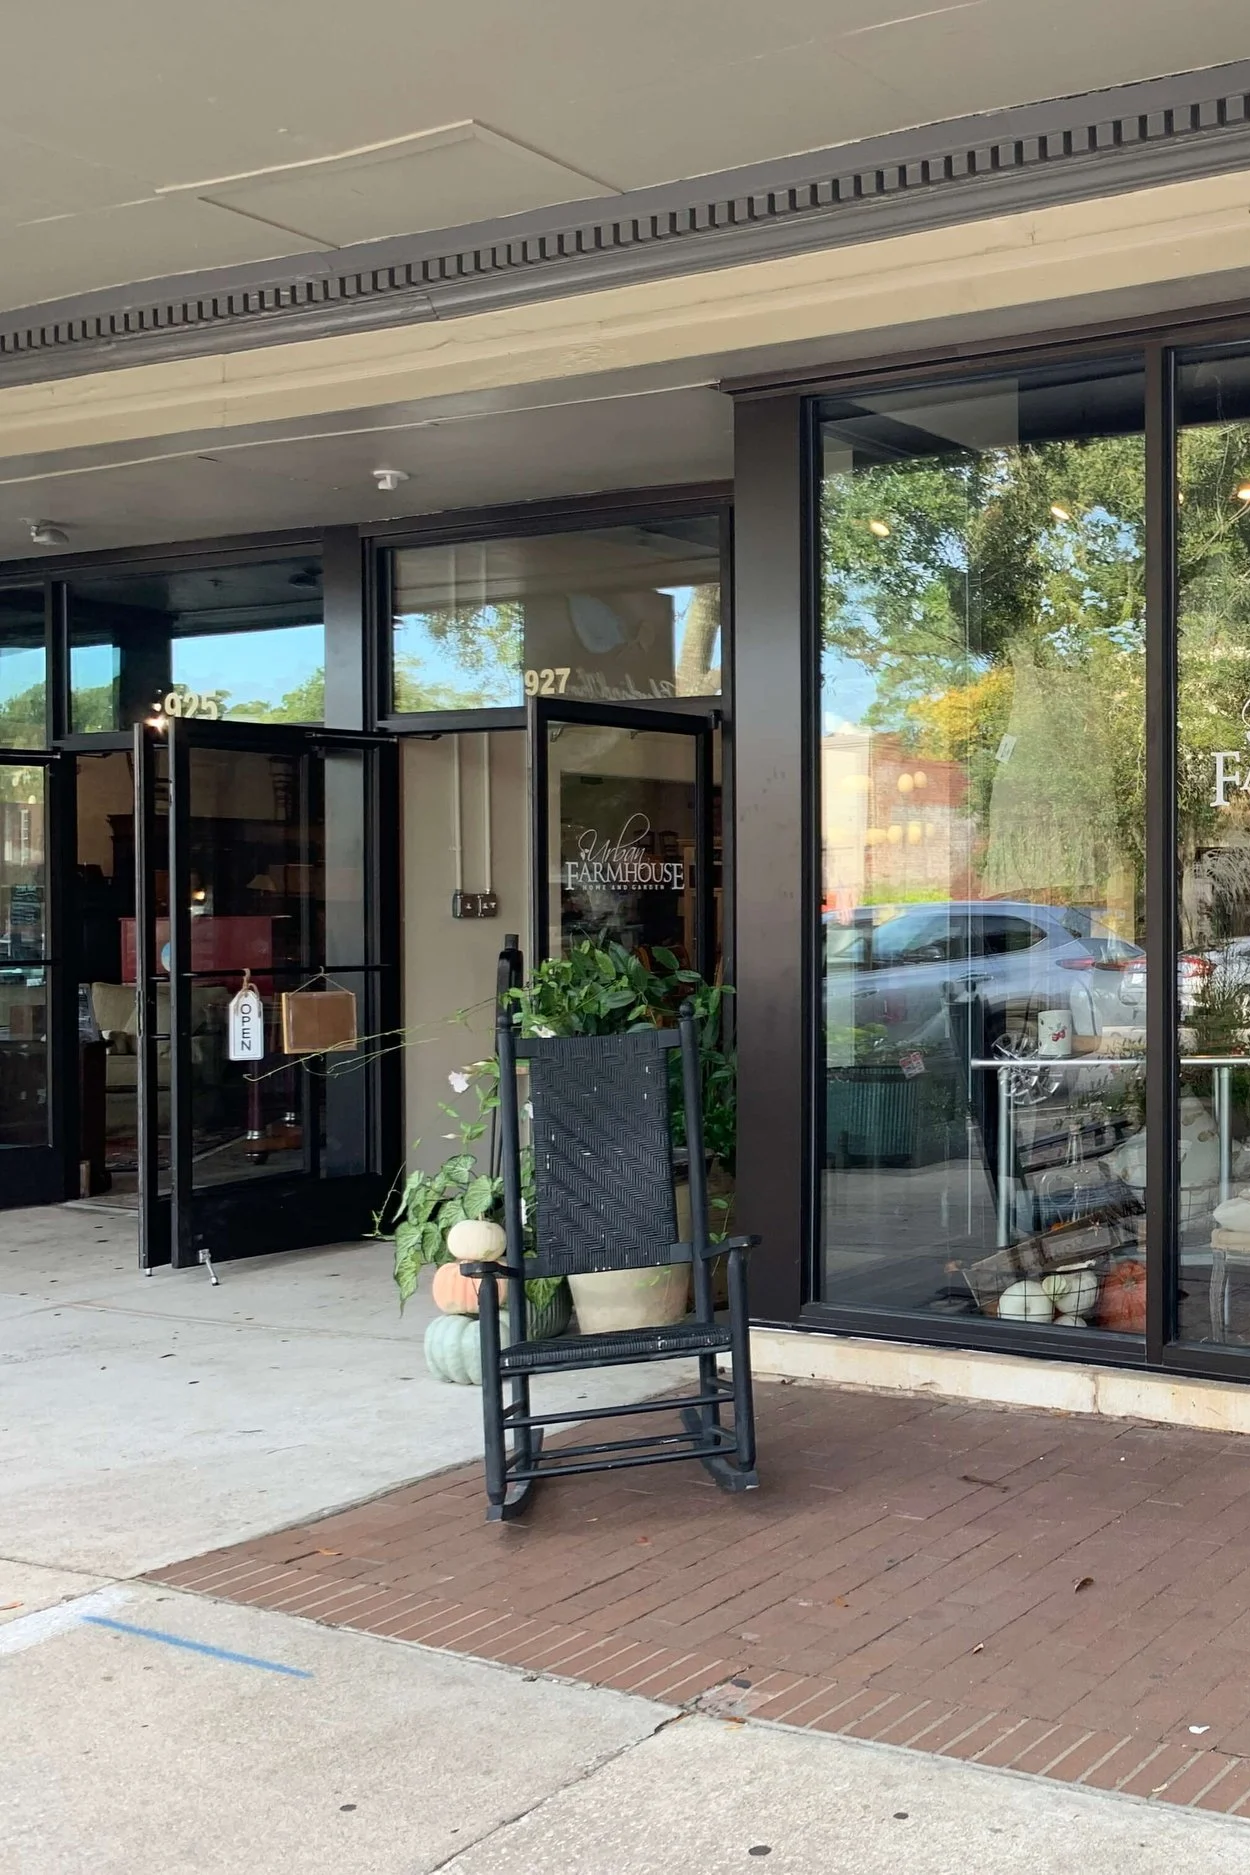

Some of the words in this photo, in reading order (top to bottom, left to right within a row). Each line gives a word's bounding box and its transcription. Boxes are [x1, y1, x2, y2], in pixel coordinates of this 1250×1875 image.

[525, 667, 571, 697] 927
[164, 691, 219, 721] 925
[578, 812, 651, 868] Urban
[565, 861, 685, 891] FARMHOUSE
[240, 1003, 252, 1051] OPEN
